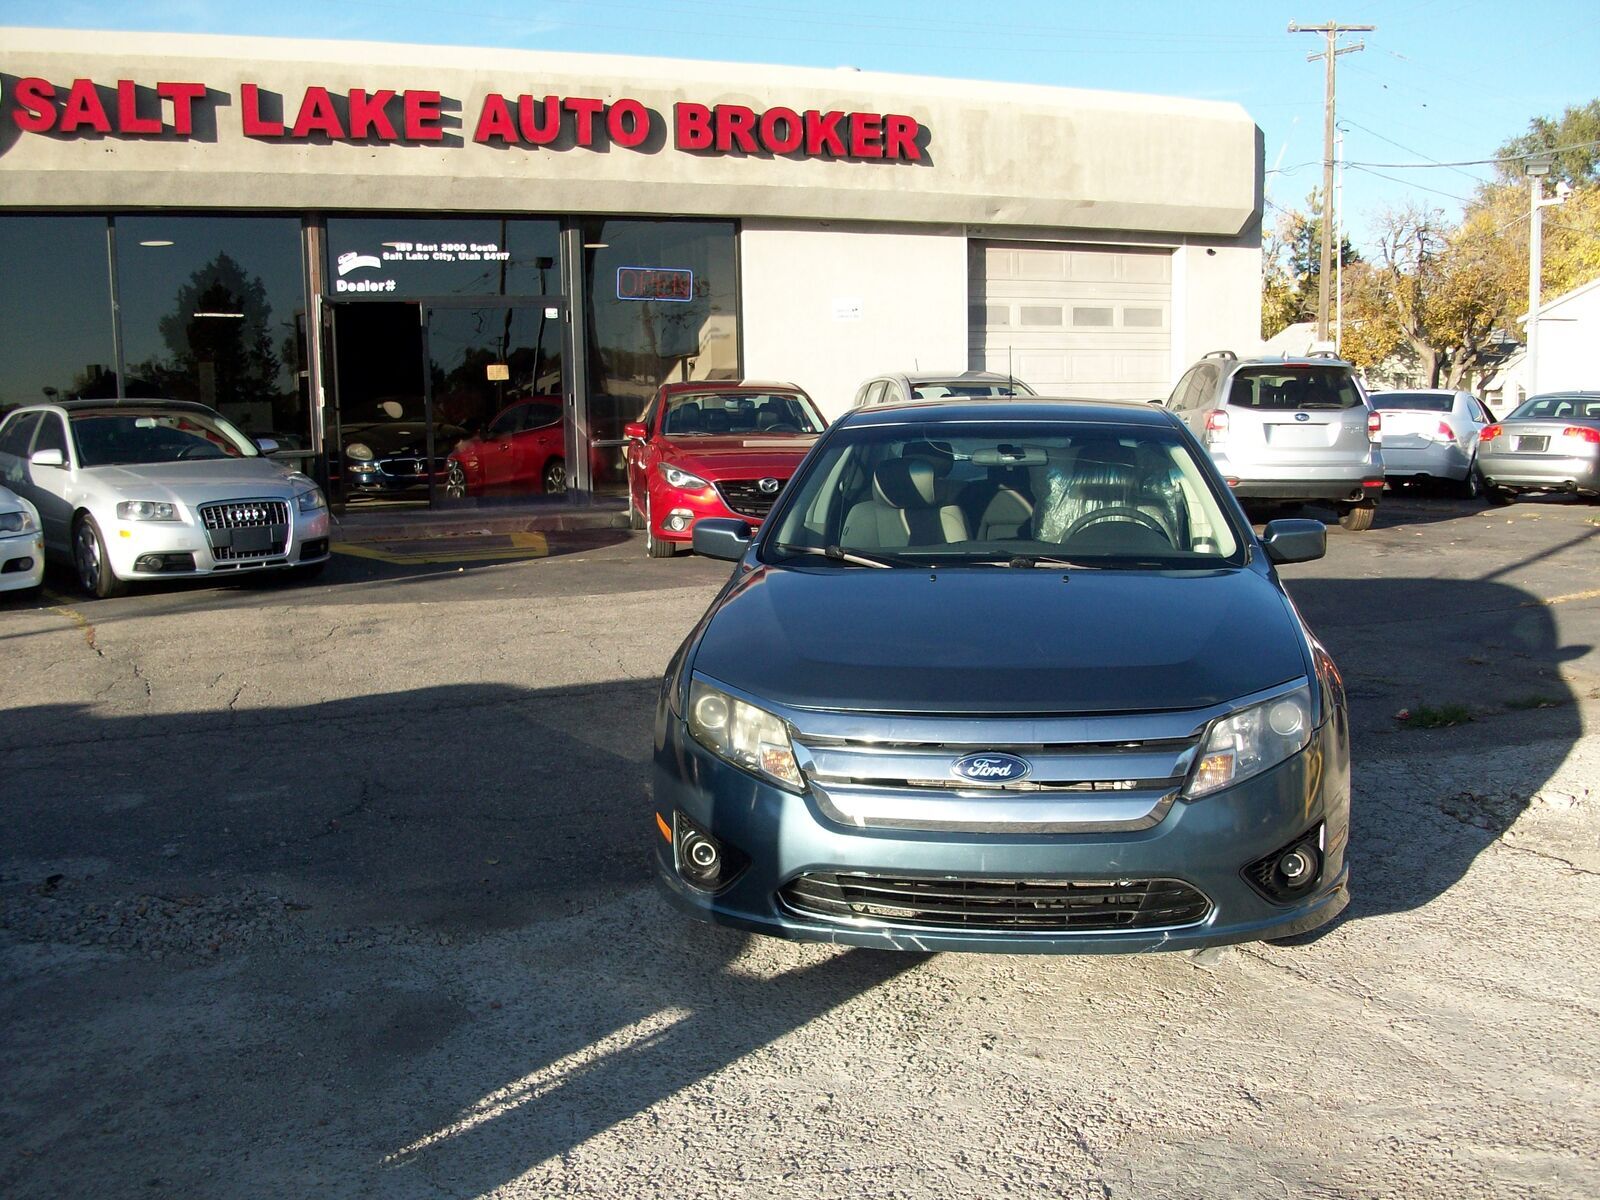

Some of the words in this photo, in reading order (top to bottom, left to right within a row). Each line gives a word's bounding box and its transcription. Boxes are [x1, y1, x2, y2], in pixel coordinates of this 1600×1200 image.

[13, 77, 206, 135] SALT
[241, 83, 443, 140] LAKE
[473, 94, 650, 148] AUTO
[674, 102, 922, 161] BROKER
[416, 243, 438, 251] East
[470, 243, 498, 252] South
[382, 252, 403, 260] Salt
[405, 252, 429, 260] Lake
[432, 252, 456, 262] City,
[458, 252, 481, 260] Utah
[336, 279, 396, 292] Dealer#
[968, 758, 1012, 777] Ford
